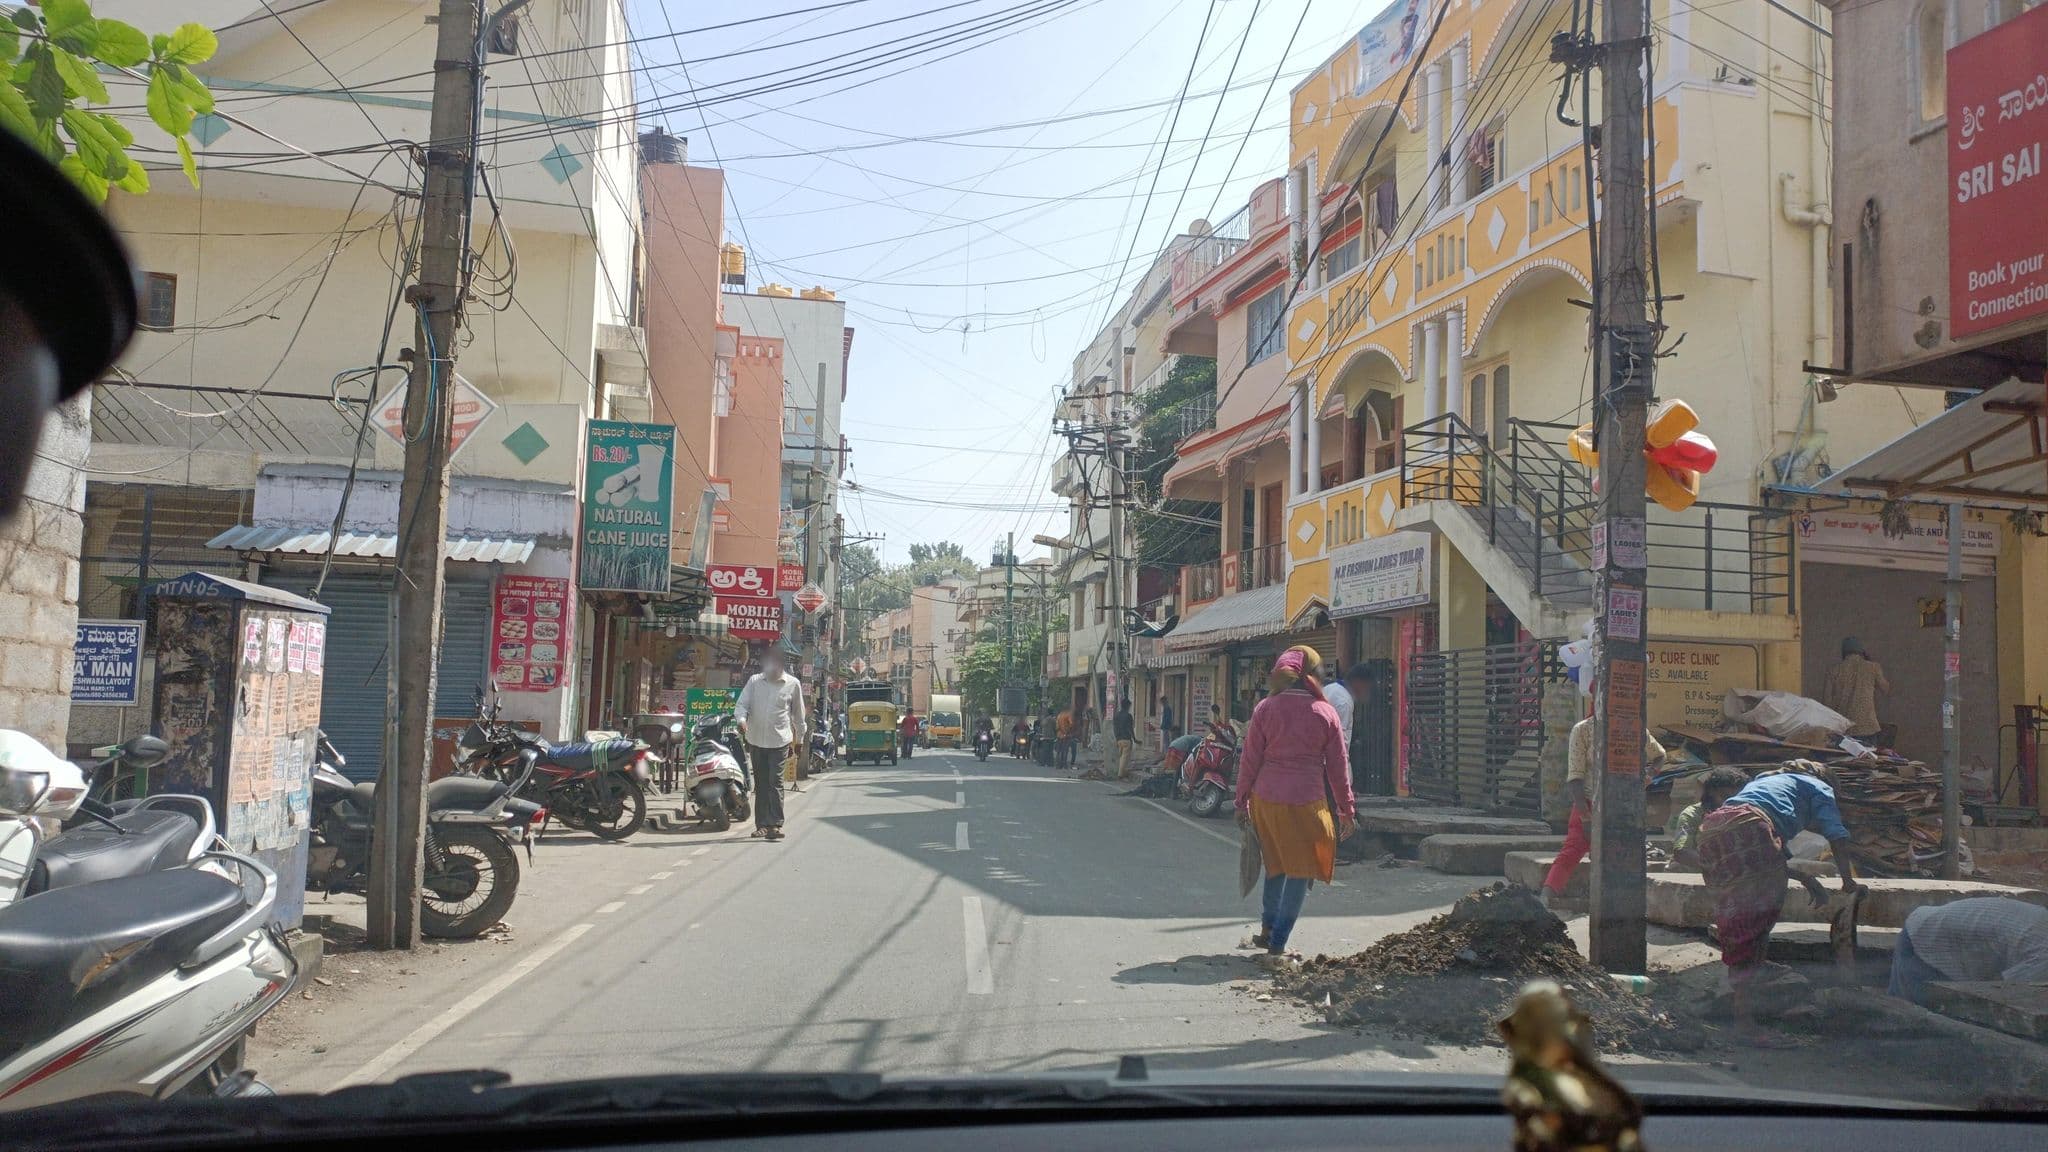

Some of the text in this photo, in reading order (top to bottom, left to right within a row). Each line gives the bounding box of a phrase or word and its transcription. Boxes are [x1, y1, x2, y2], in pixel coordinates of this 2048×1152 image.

[1958, 104, 1985, 150] ಶ್ರೀ
[1958, 142, 2040, 203] SRI SAI
[1969, 253, 2044, 292] Book your
[594, 508, 663, 526] NATURAL
[587, 528, 669, 548] CANE JUICE
[1926, 528, 1944, 537] AND
[1968, 530, 1993, 540] CLINIC
[1614, 540, 1641, 548] LADIES
[1346, 559, 1374, 577] FASHION
[1374, 553, 1398, 571] LADIES
[1399, 546, 1425, 566] TAILOR
[1612, 595, 1638, 610] PG
[727, 604, 780, 618] MOBILE
[1610, 609, 1637, 618] LADIES
[727, 618, 779, 631] REPAIR
[1660, 651, 1686, 664] CURE
[1690, 653, 1720, 666] CLINIC
[74, 661, 133, 677] A" MAIN
[1667, 670, 1708, 681] AVAILABLE
[73, 677, 131, 686] ESHWARA LAYOUT
